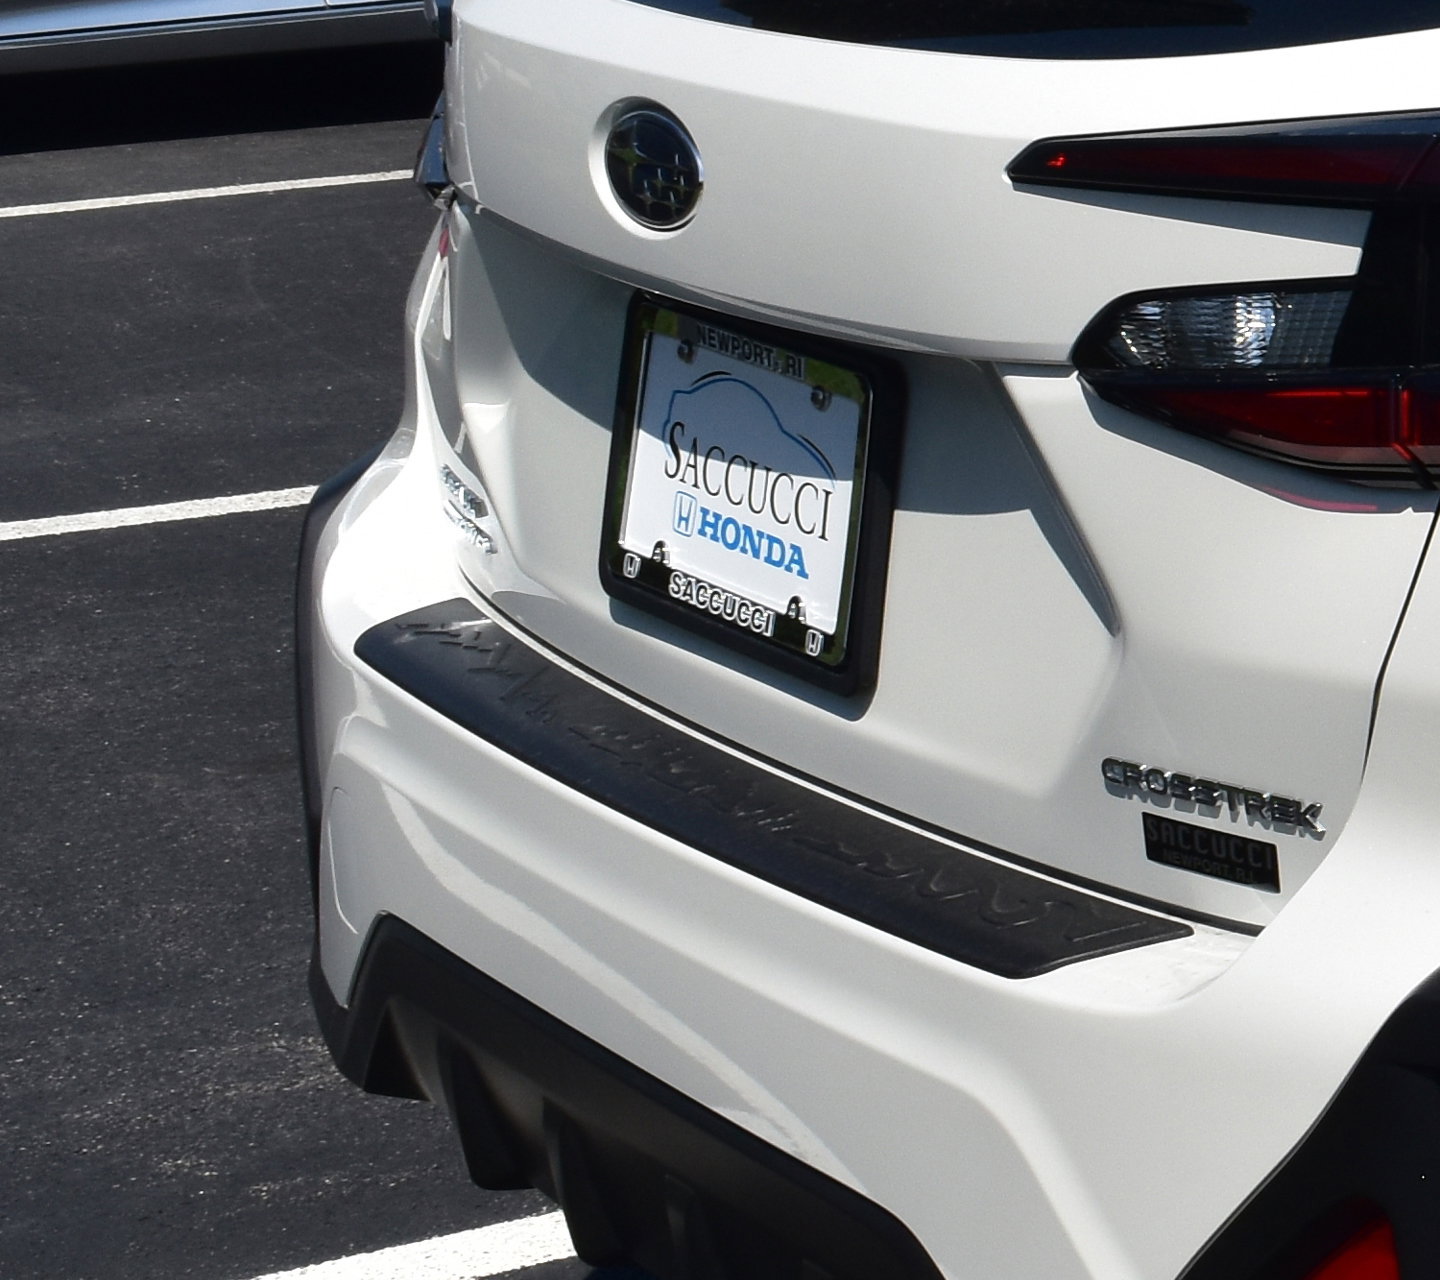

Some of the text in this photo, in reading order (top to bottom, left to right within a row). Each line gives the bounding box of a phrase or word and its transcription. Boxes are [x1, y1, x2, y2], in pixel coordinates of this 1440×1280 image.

[786, 354, 806, 381] RI
[664, 420, 835, 542] SACCUCCI
[697, 506, 809, 580] HONDA
[668, 572, 777, 638] SACCUCCI
[1101, 757, 1326, 835] CROSSTREK
[1147, 816, 1274, 871] SACCUCCI
